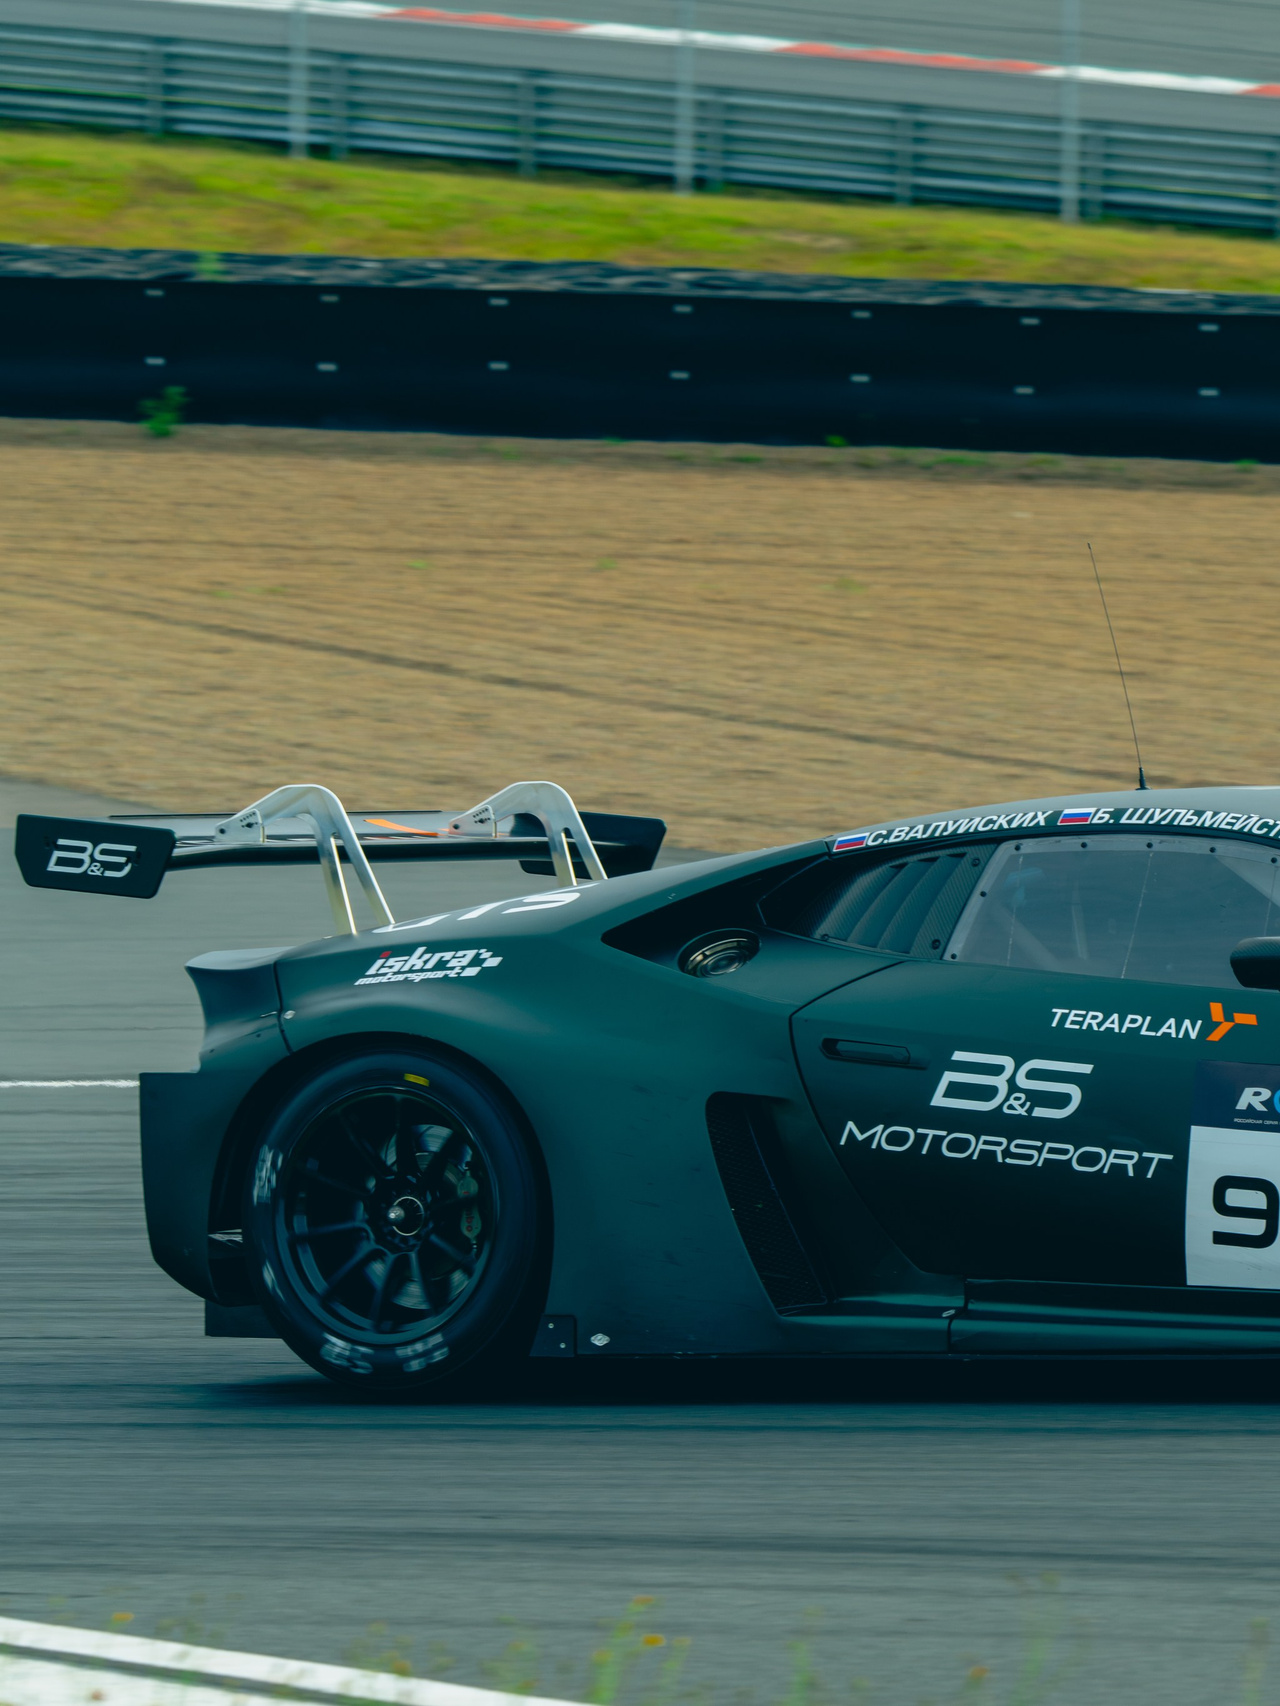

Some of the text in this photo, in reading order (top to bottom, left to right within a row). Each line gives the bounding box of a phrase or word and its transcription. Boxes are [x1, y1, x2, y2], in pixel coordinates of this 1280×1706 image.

[1091, 808, 1115, 824] Б.
[46, 838, 137, 878] B&S
[353, 966, 463, 986] motorsport
[364, 946, 479, 976] iskra
[1050, 1008, 1202, 1040] TERAPLAN
[930, 1050, 1094, 1120] B&S
[840, 1120, 1174, 1179] MOTORSPORT
